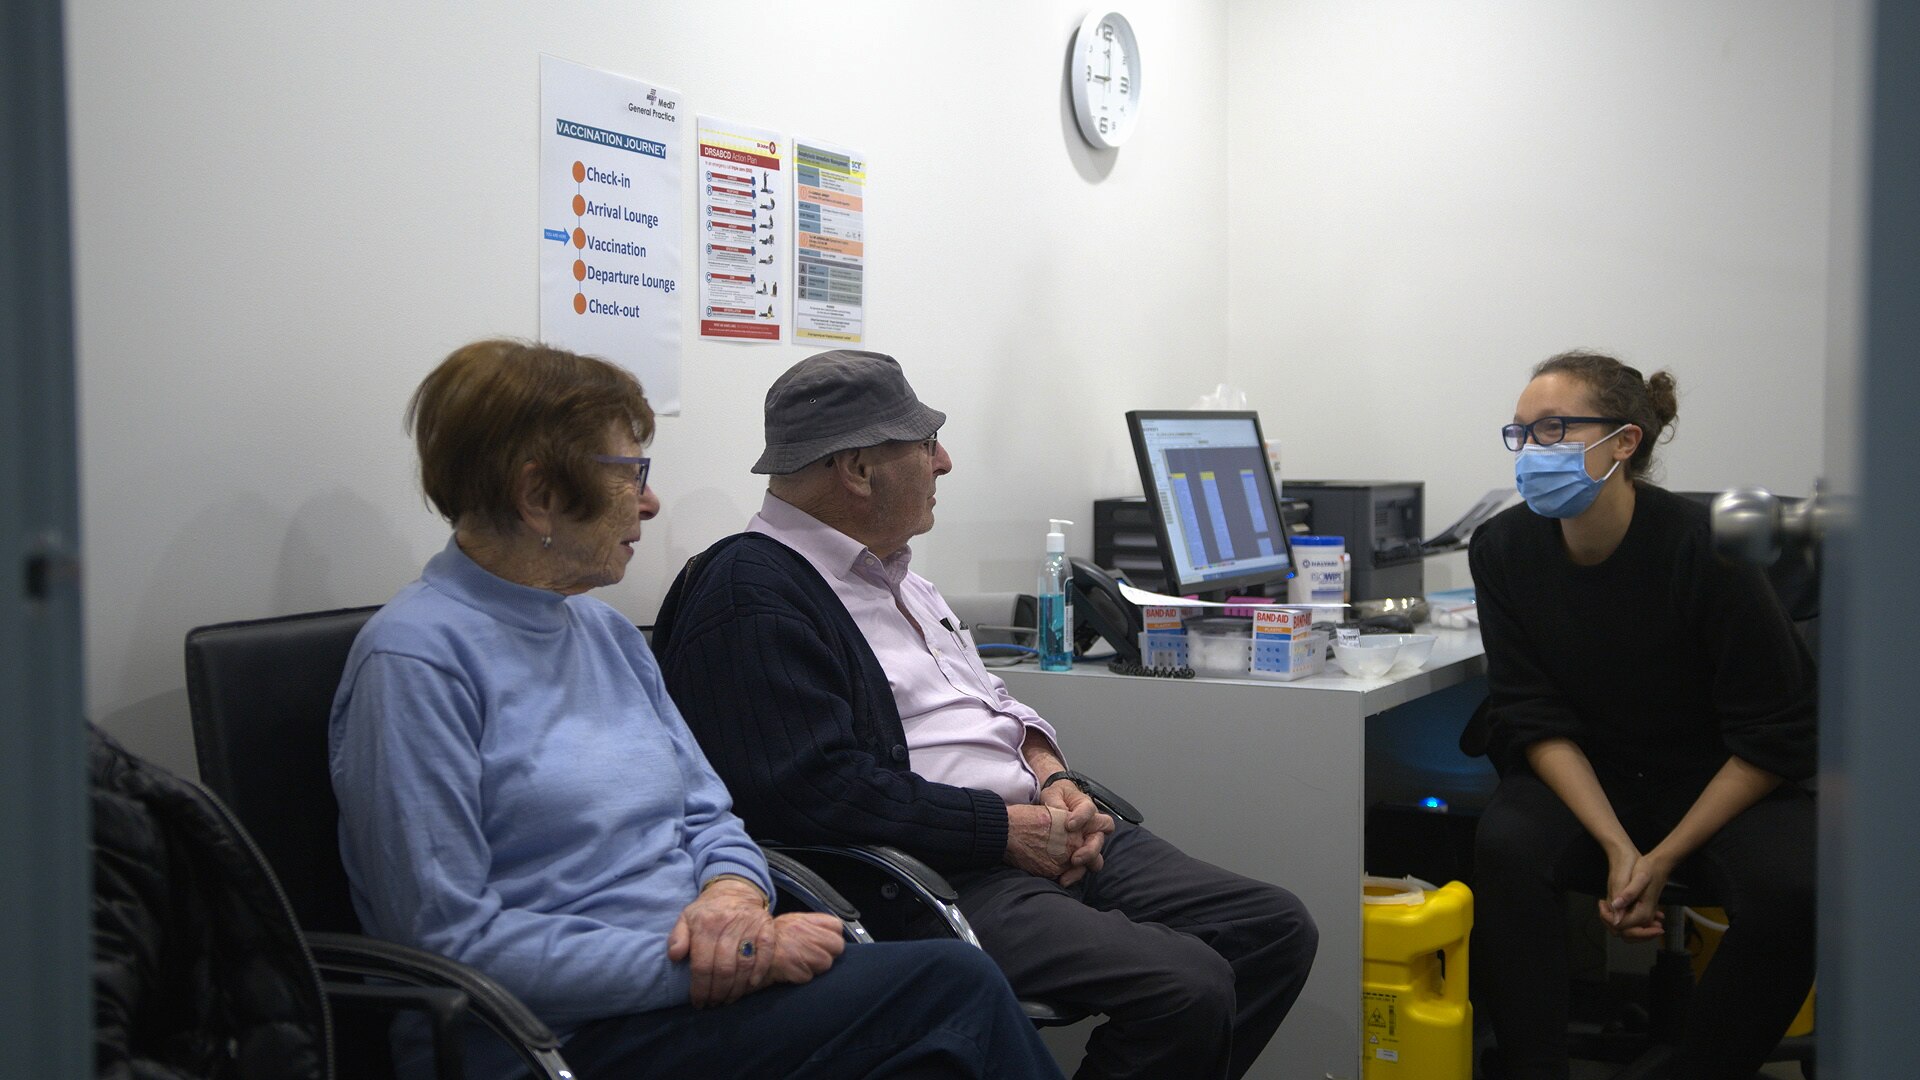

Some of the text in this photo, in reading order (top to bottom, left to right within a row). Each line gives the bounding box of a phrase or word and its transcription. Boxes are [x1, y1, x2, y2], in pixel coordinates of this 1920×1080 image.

[628, 102, 676, 122] General Practice
[658, 98, 676, 110] Medi7
[557, 120, 666, 157] VACCINATION JOURNEY
[704, 147, 757, 164] DRSABCD Action Plan
[586, 166, 630, 188] Check-in
[586, 200, 658, 228] Arrival Lounge
[587, 235, 646, 258] Vaccination
[588, 266, 675, 293] Departure Lounge
[589, 299, 640, 318] Check-out
[1146, 608, 1176, 617] BAND-AID
[1257, 612, 1289, 624] BAND-AID
